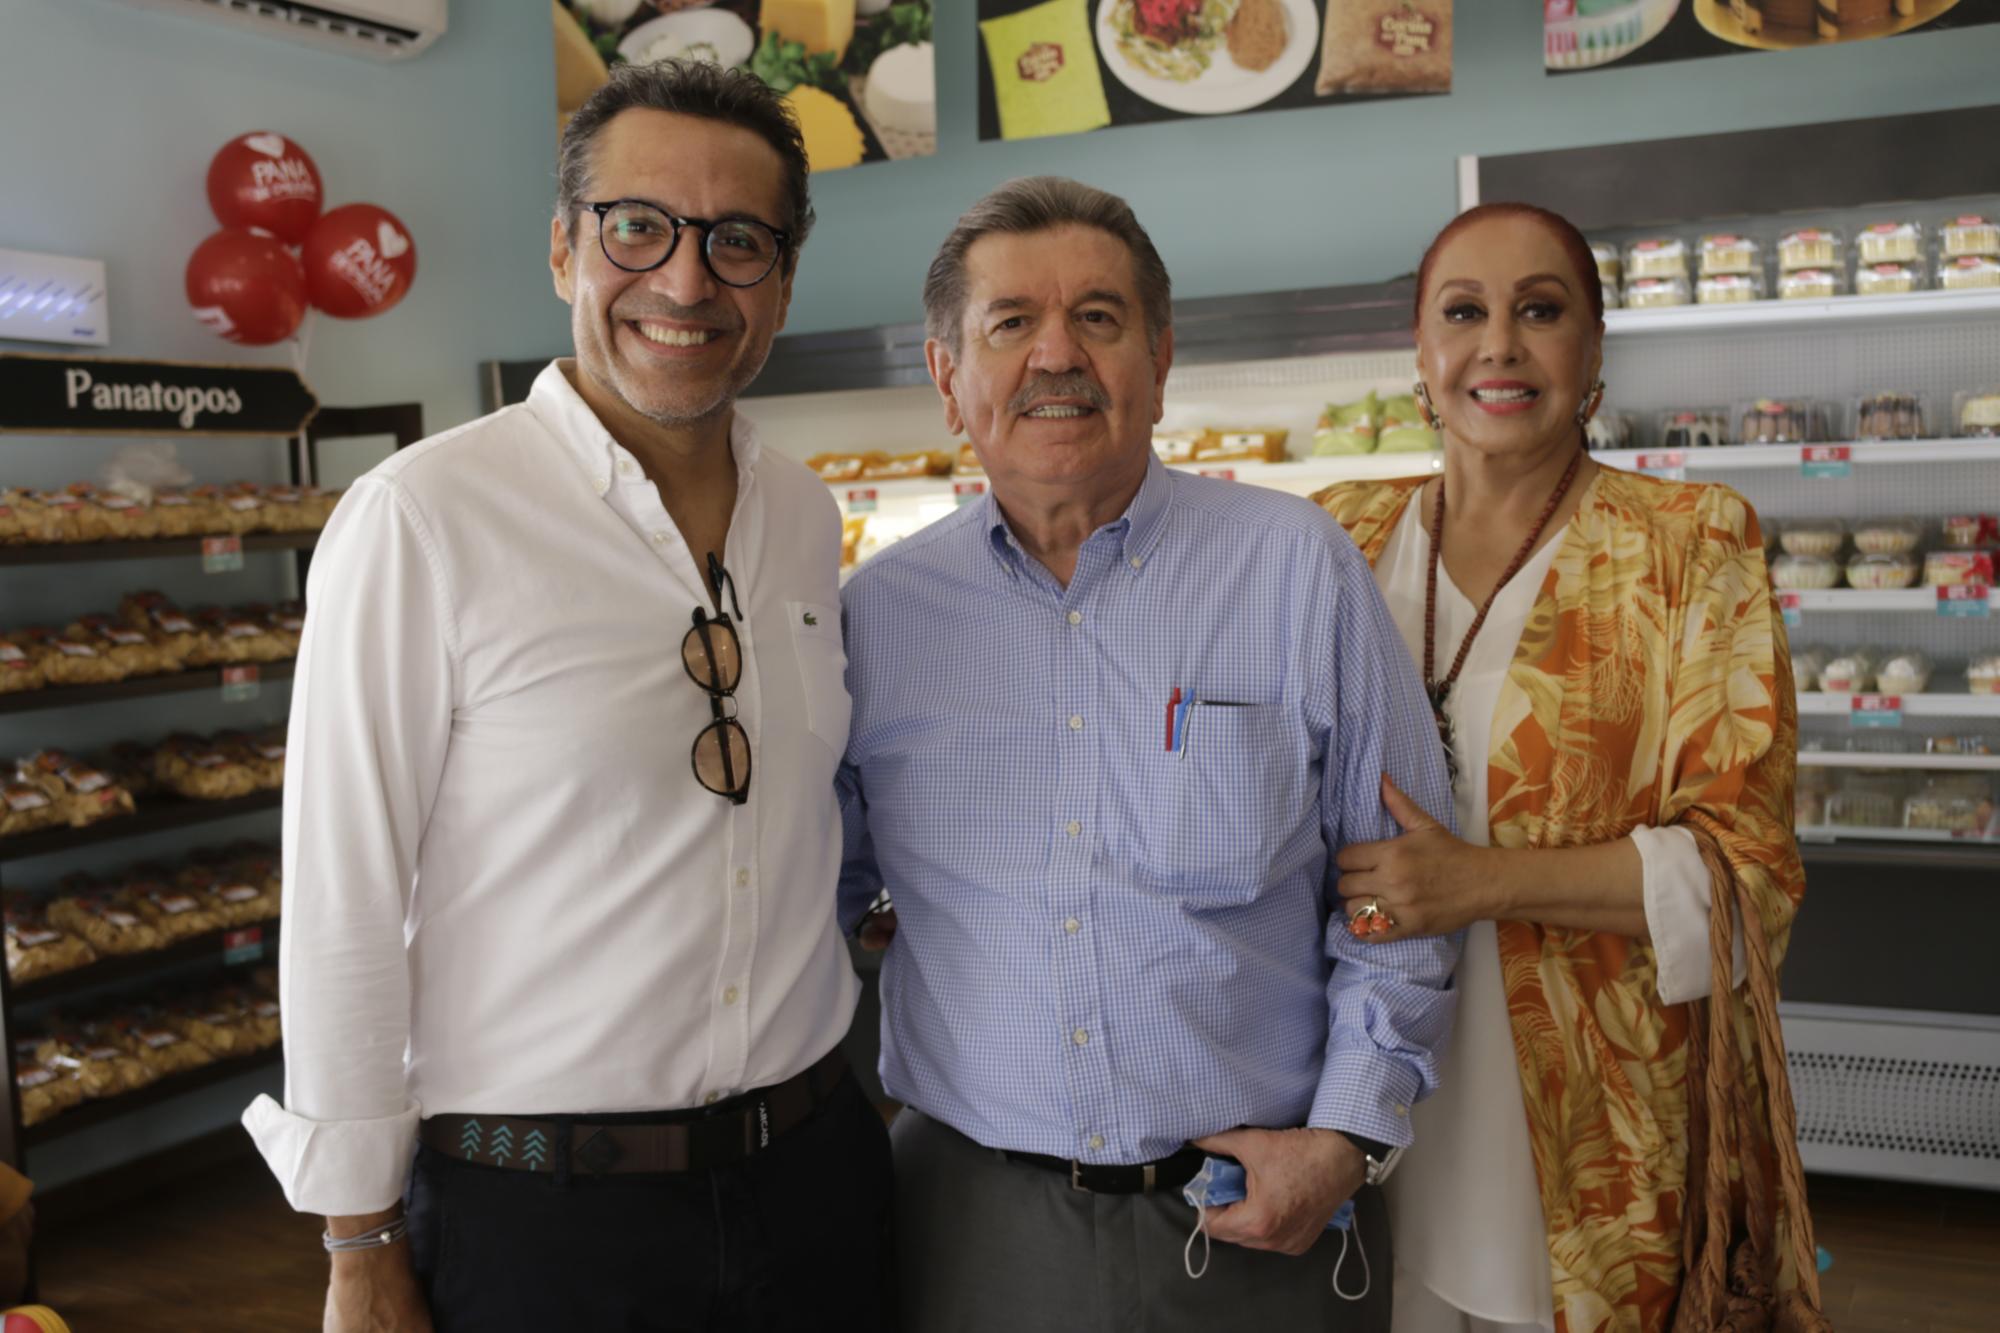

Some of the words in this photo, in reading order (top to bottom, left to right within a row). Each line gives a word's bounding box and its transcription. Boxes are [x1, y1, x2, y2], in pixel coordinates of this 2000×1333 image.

[251, 159, 312, 187] PANA
[344, 238, 396, 293] PANA
[65, 368, 242, 429] Panatopos
